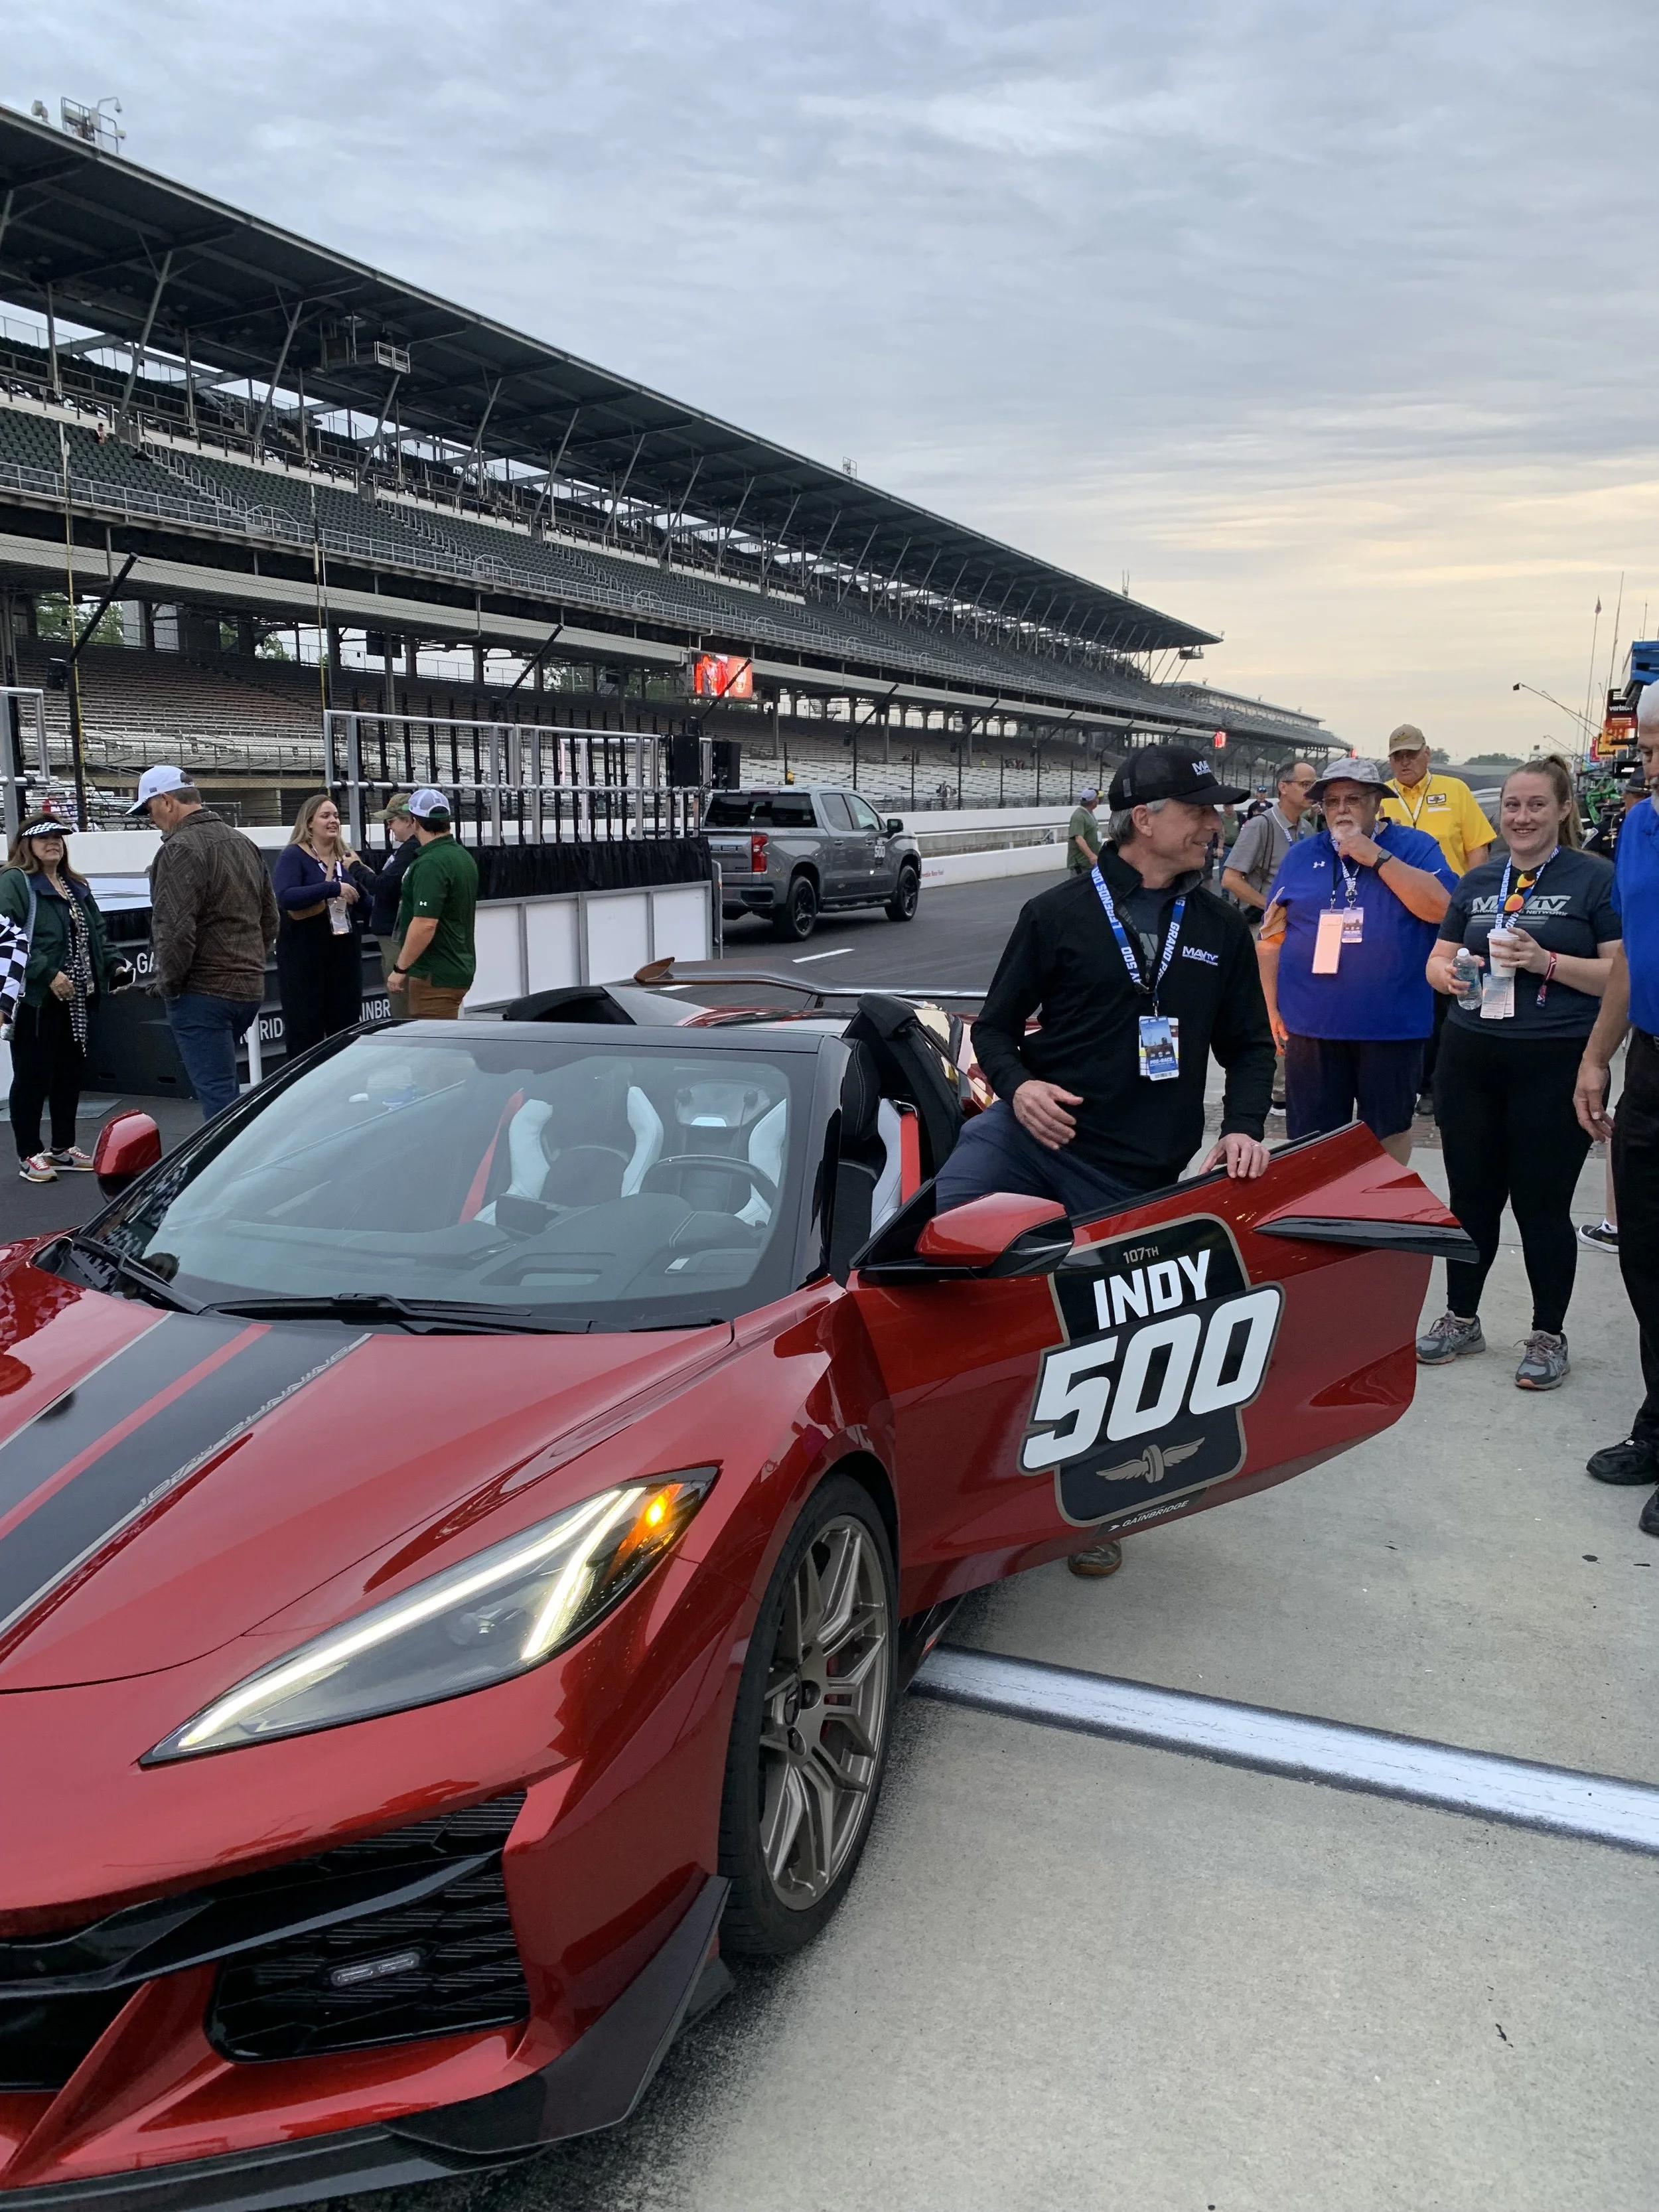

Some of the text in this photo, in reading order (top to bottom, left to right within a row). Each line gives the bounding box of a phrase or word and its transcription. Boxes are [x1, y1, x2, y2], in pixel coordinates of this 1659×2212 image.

[1163, 921, 1180, 962] GRAND
[1123, 1246, 1159, 1264] 107TH
[1093, 1249, 1211, 1330] INDY
[224, 1345, 350, 1441] RUNNING
[1023, 1289, 1280, 1469] 500
[1122, 1500, 1190, 1527] GAINBRIDGE
